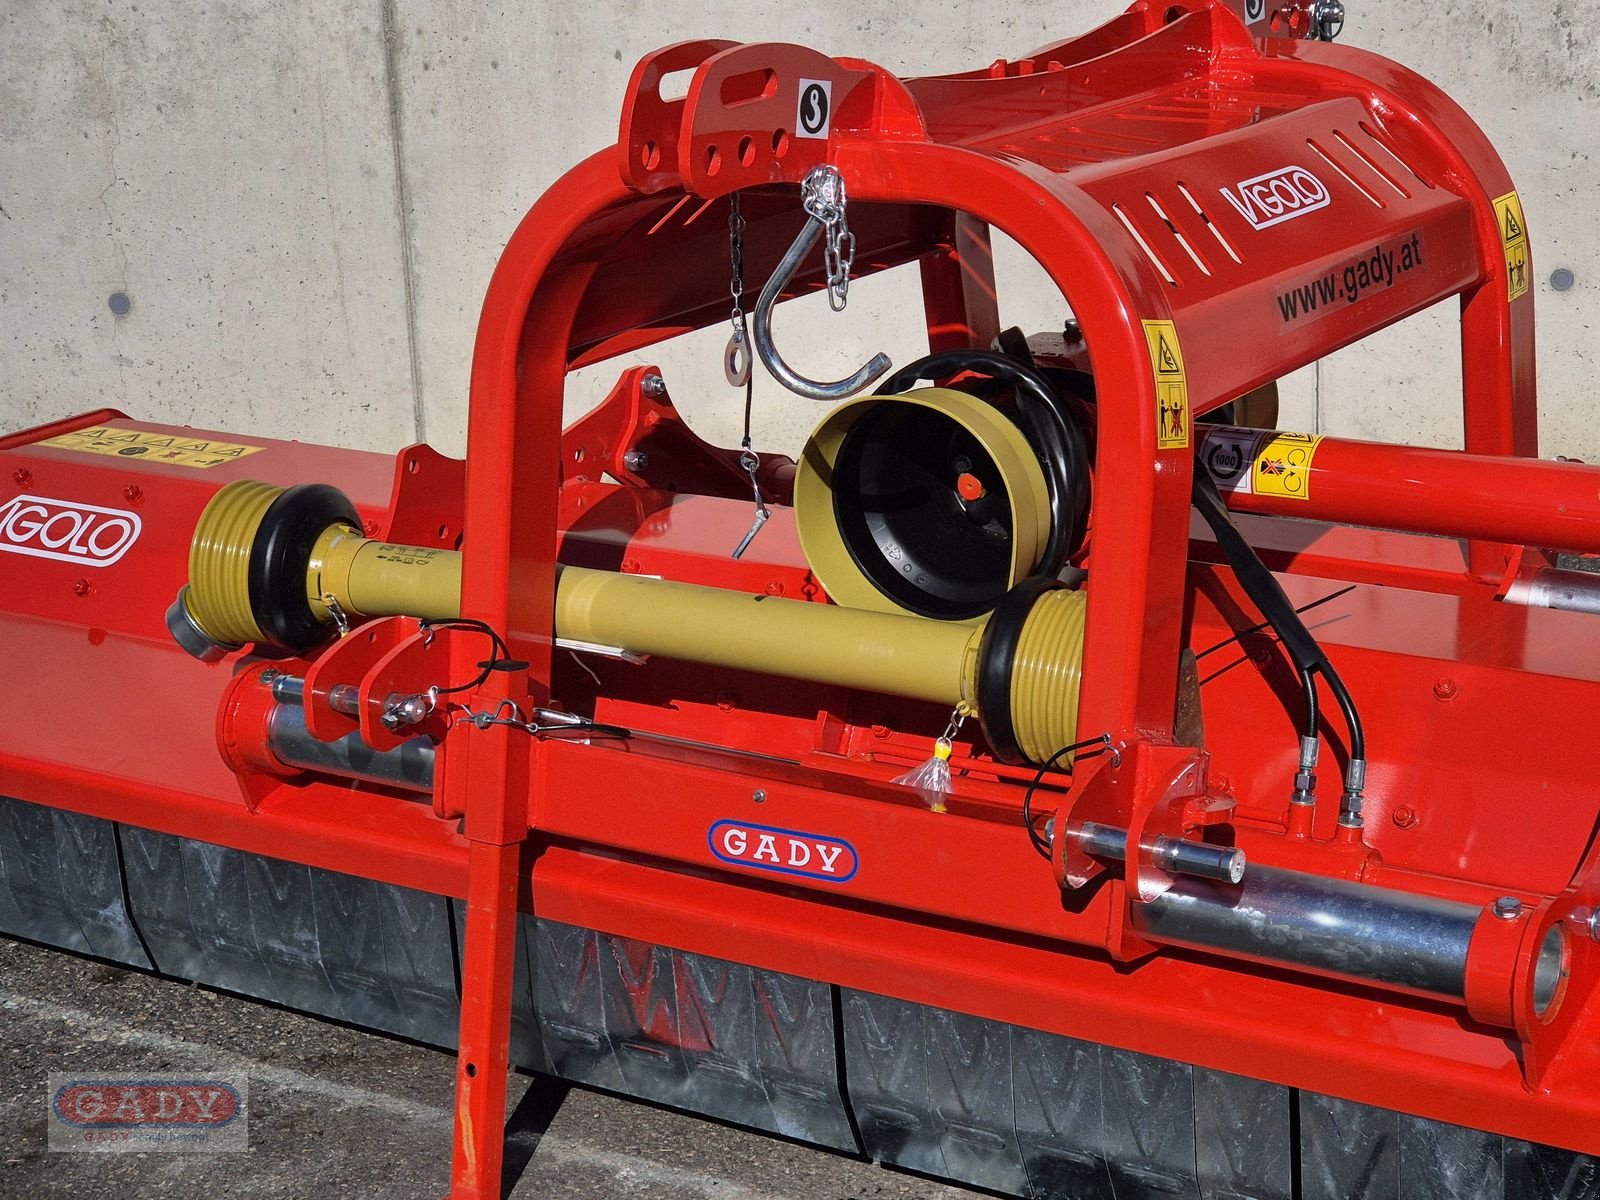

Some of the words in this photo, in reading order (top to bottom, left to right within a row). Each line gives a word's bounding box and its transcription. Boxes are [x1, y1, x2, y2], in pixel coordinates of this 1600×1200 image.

[1219, 171, 1324, 225] VIGOLO
[1277, 233, 1422, 322] www.gady.at
[1215, 454, 1236, 467] 1000
[0, 502, 132, 557] IGOLO
[723, 829, 842, 872] GADY
